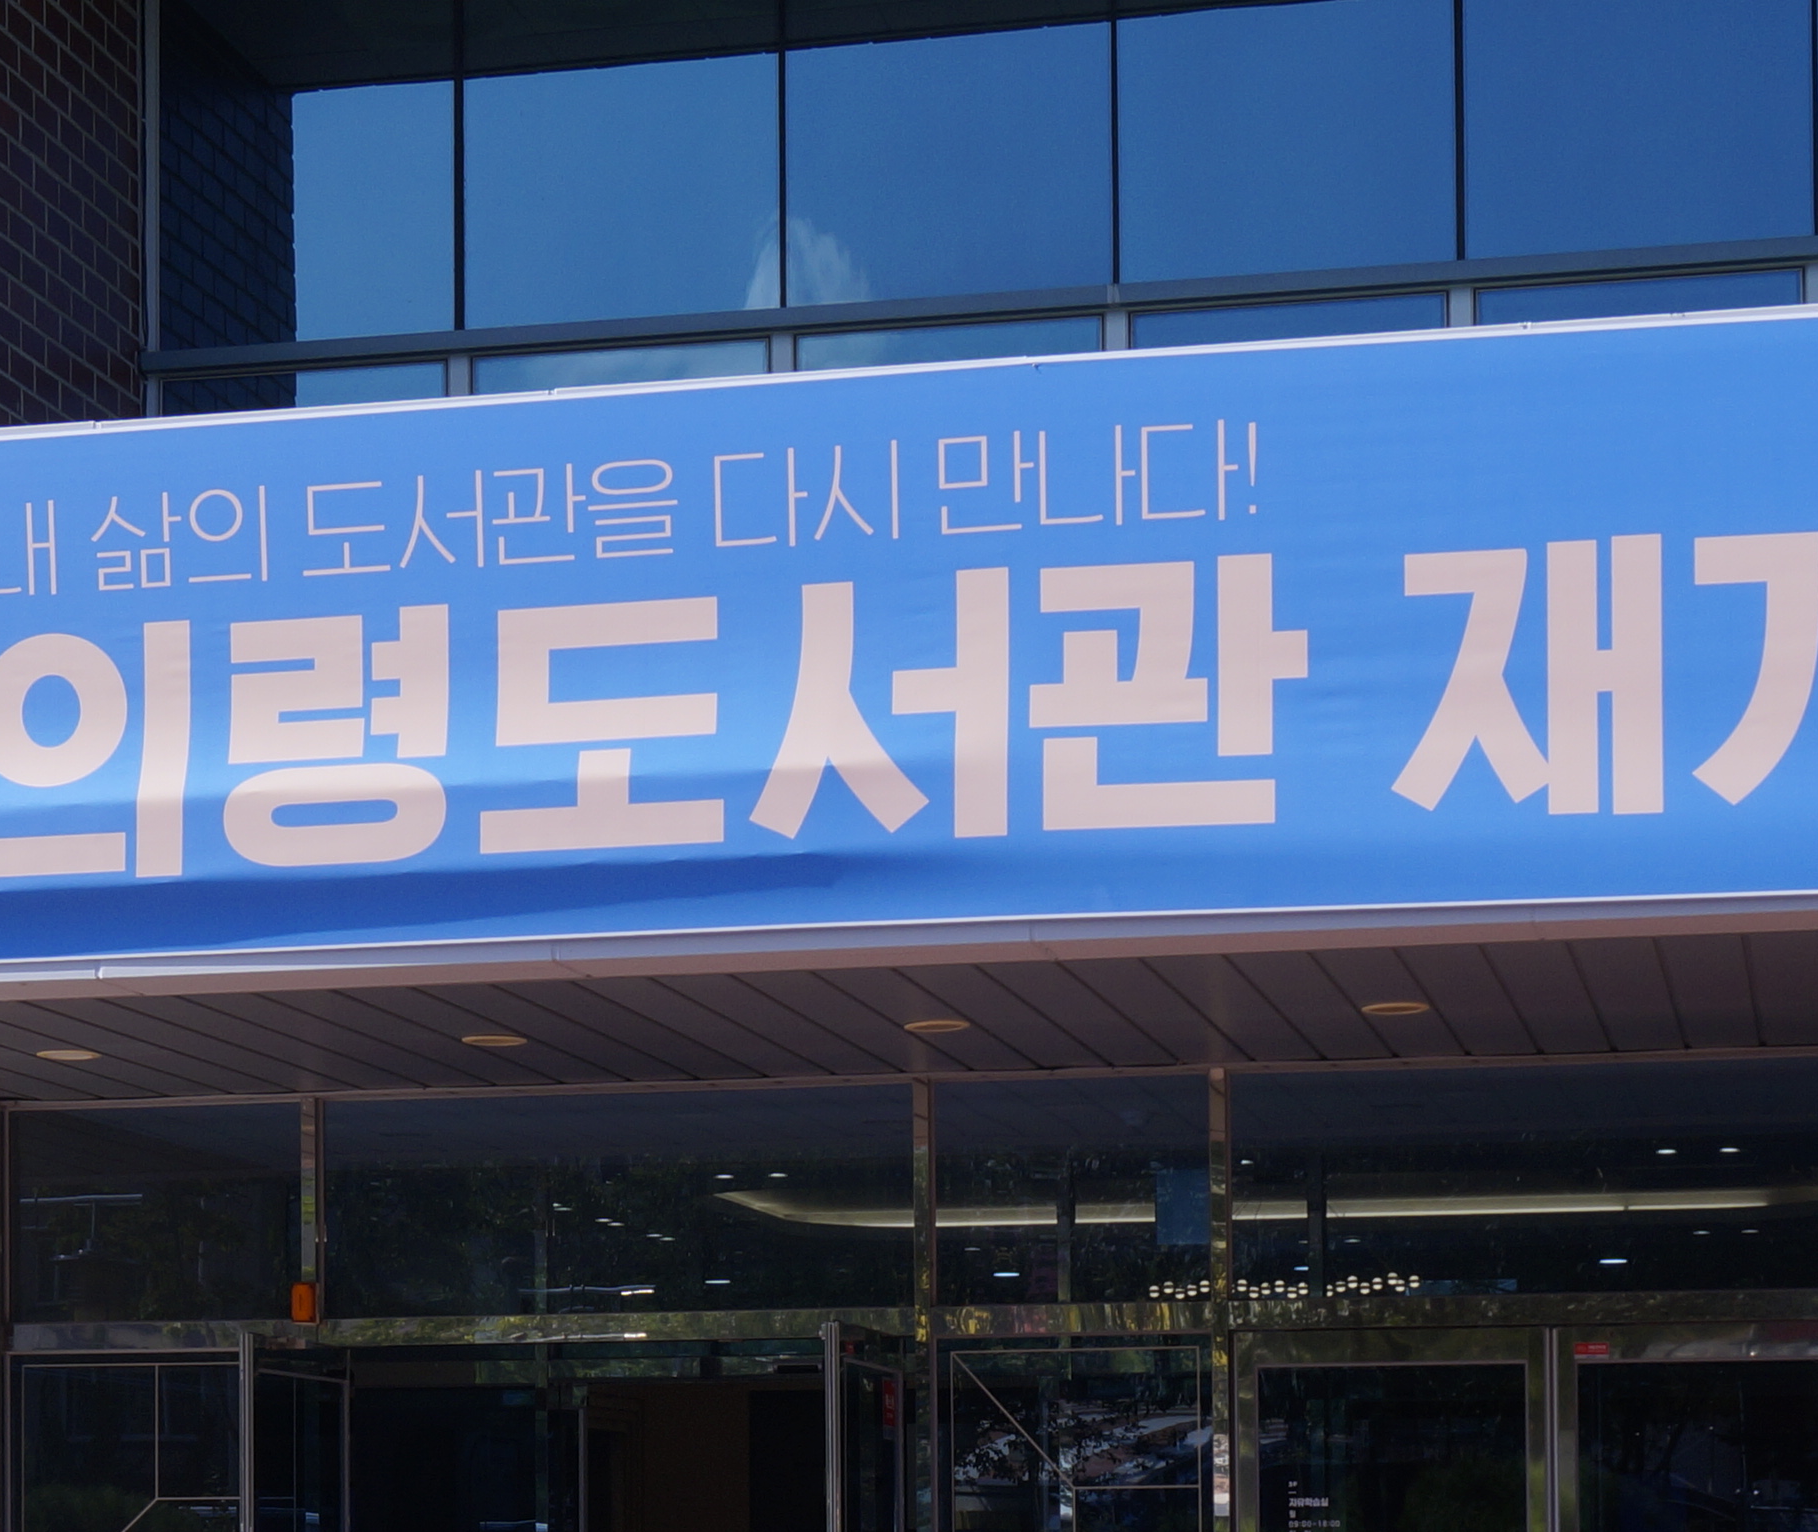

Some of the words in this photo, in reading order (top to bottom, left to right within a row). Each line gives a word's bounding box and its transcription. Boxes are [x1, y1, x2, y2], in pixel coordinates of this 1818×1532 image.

[89, 485, 271, 595] 삶의
[302, 456, 680, 579] 도서관을
[712, 439, 900, 549] 다시
[936, 419, 1258, 536] 만나다!
